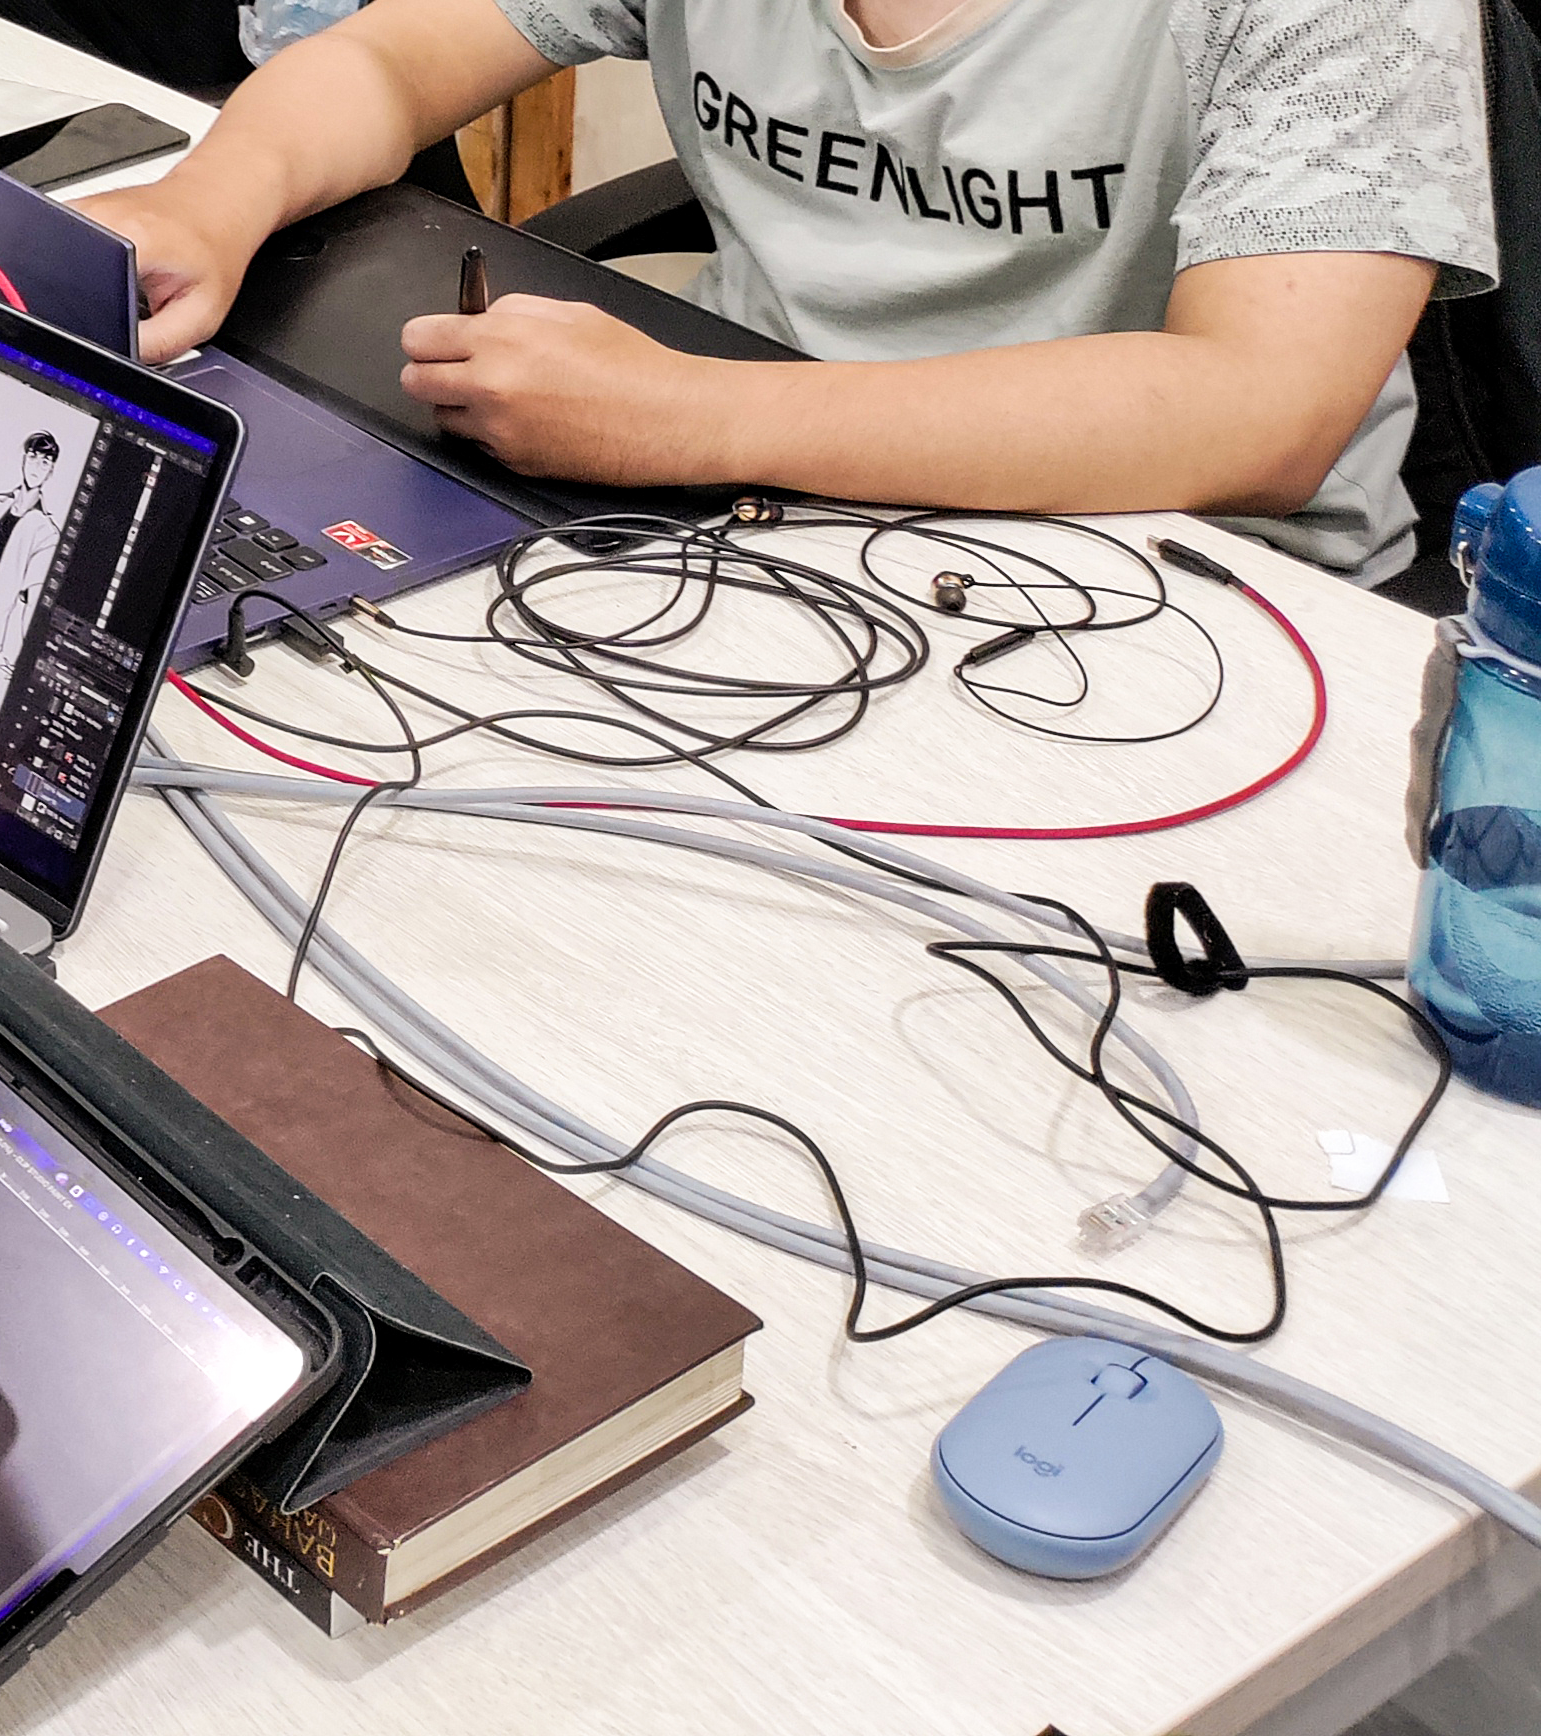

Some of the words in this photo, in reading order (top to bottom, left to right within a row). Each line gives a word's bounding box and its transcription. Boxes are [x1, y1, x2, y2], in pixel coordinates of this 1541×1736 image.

[693, 71, 1125, 235] GREENLIGHT
[1014, 1445, 1064, 1477] logi
[242, 1531, 301, 1594] THE
